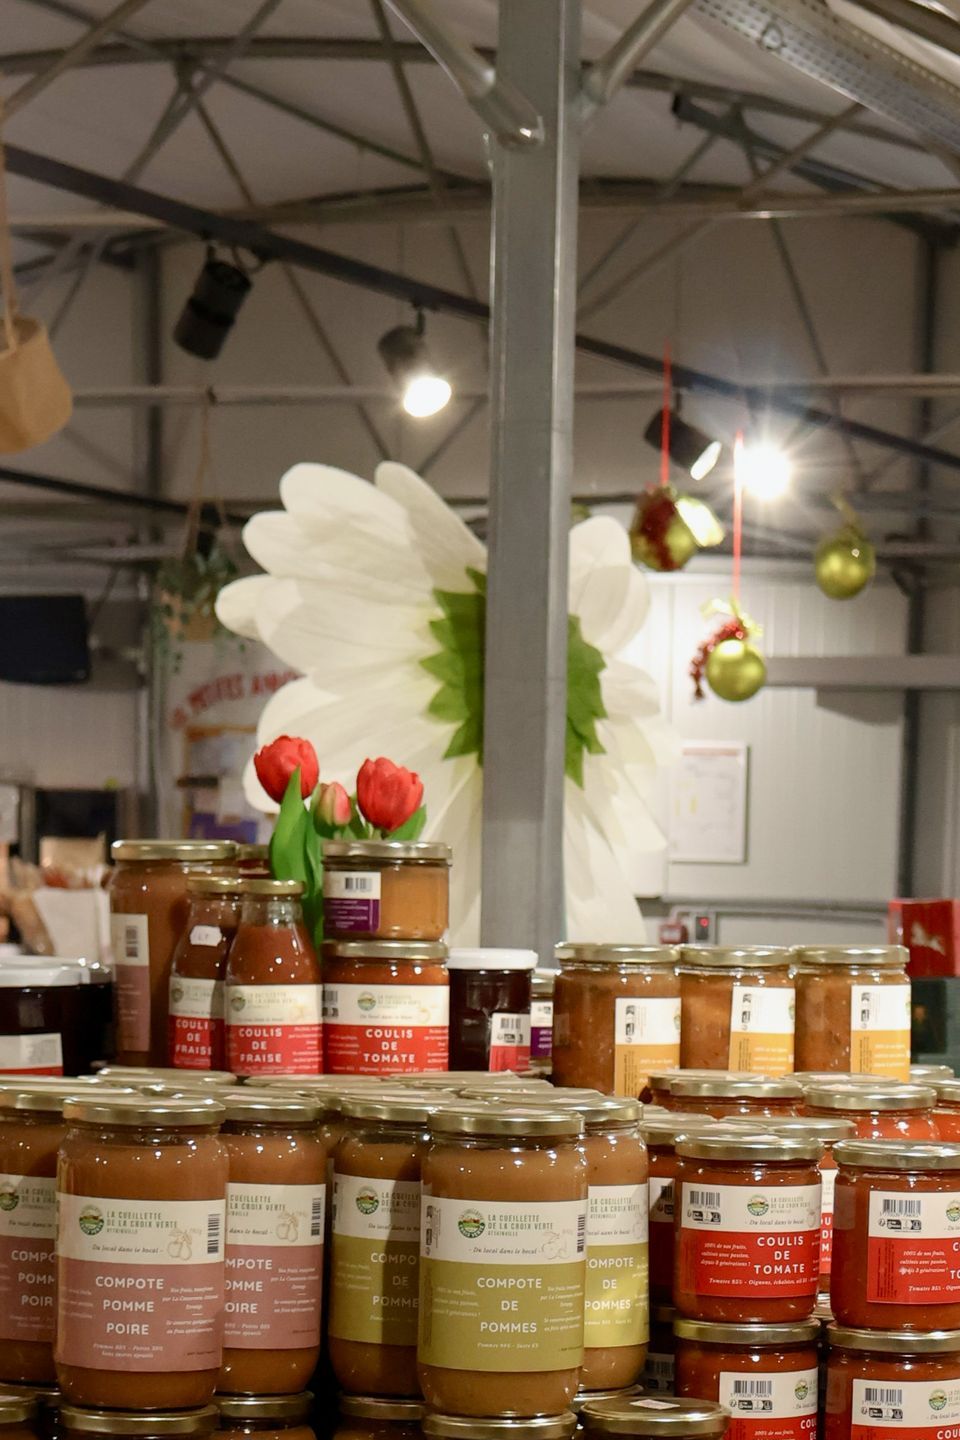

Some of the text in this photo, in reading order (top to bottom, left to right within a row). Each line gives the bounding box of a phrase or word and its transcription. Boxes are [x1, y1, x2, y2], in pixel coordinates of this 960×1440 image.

[176, 1020, 215, 1030] COULI
[187, 1033, 200, 1042] DE
[239, 1028, 282, 1037] COULIS
[366, 1029, 413, 1038] COULIS
[252, 1042, 267, 1050] DE
[382, 1042, 397, 1050] DE
[240, 1054, 282, 1062] FRAISE
[364, 1053, 415, 1063] TOMATE
[757, 1236, 804, 1246] COULIS
[11, 1250, 54, 1262] COMP
[370, 1252, 416, 1264] COMPO
[774, 1251, 790, 1260] DE
[225, 1259, 272, 1270] MPOTE
[587, 1258, 634, 1269] OMPOTE
[754, 1264, 804, 1274] TOMATE
[18, 1272, 54, 1284] POM
[96, 1276, 164, 1289] COMPOTE
[392, 1276, 408, 1286] DE
[225, 1281, 263, 1291] OMME
[477, 1278, 542, 1289] COMPOTE
[603, 1280, 616, 1289] DE
[21, 1295, 52, 1306] POIR
[372, 1296, 418, 1308] POMME
[585, 1300, 631, 1310] POMMES
[103, 1300, 154, 1312] POMME
[225, 1303, 258, 1313] OIRE
[501, 1301, 518, 1311] DE
[107, 1323, 149, 1335] POIRE
[480, 1323, 537, 1333] POMMES
